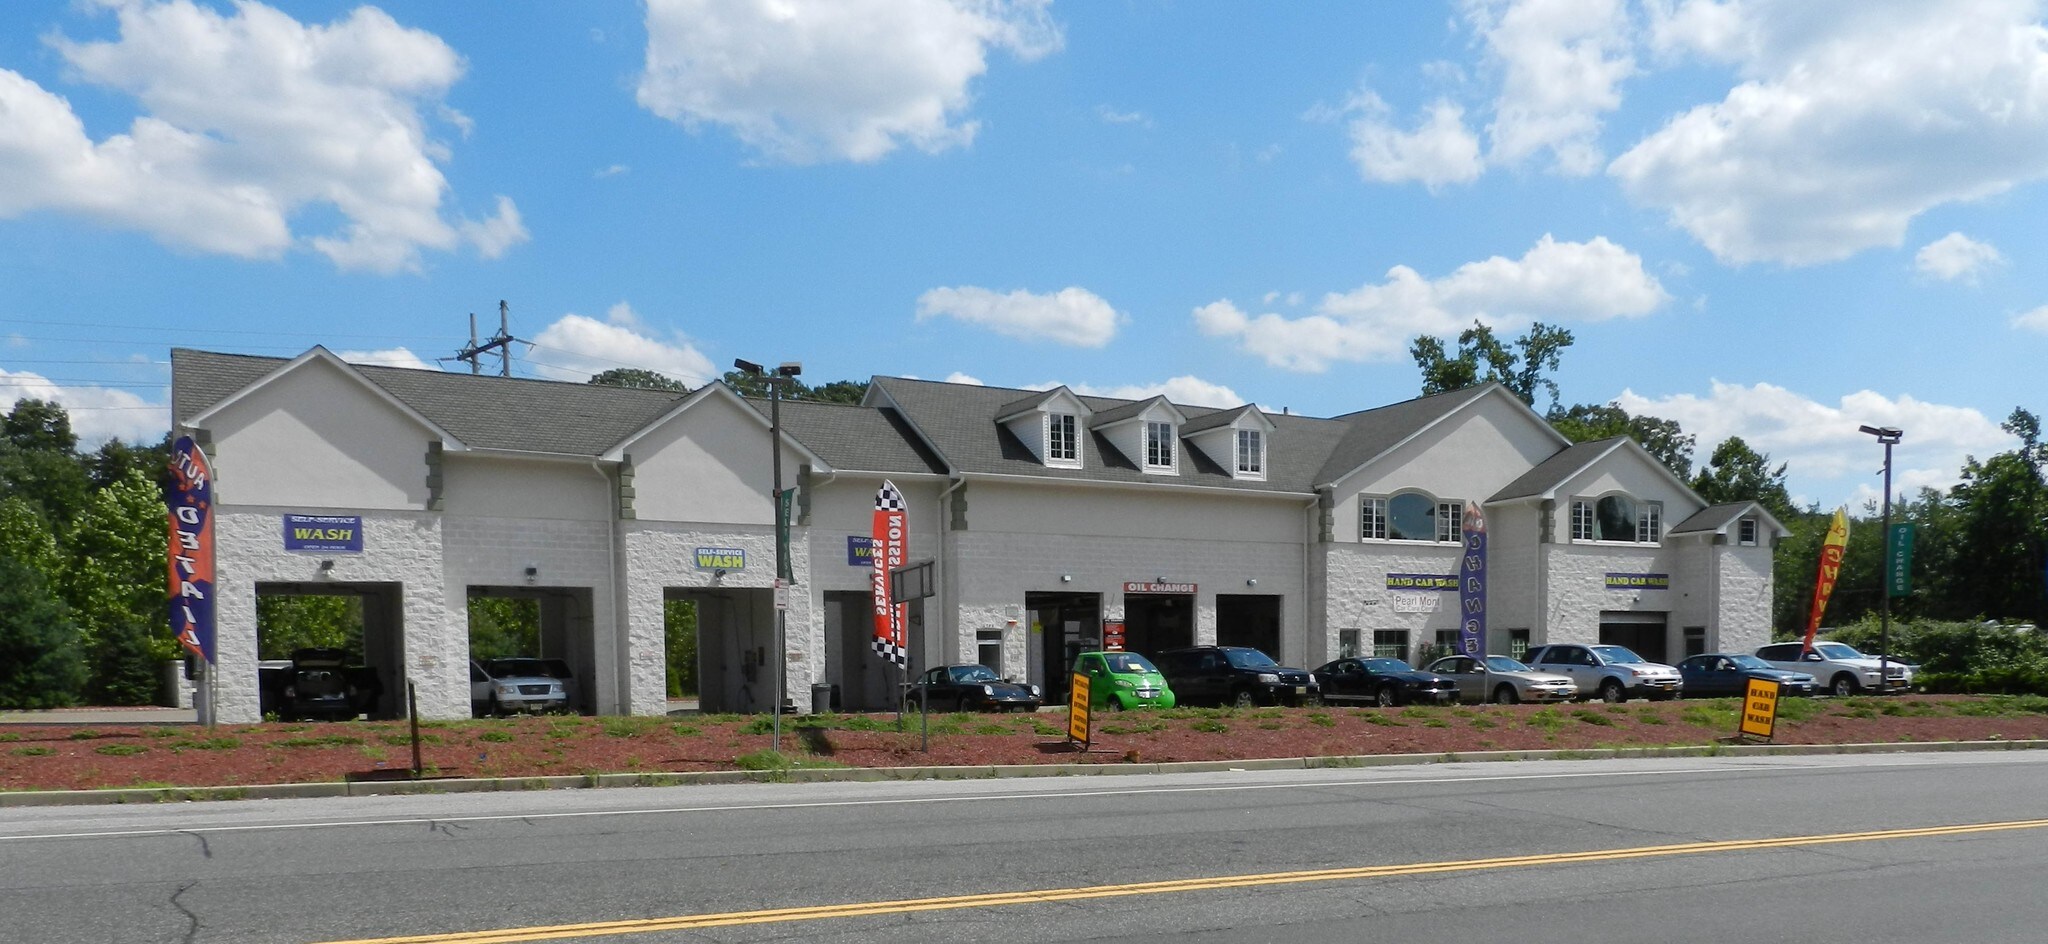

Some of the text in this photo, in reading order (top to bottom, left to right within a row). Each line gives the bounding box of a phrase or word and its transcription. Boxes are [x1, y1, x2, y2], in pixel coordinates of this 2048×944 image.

[291, 515, 356, 524] SELF-SERVICE
[294, 528, 353, 541] WASH
[1898, 527, 1907, 547] OIL
[855, 547, 874, 556] WA
[698, 555, 743, 568] WASH
[1895, 551, 1905, 590] CHANGE
[1387, 577, 1459, 587] HAND CAR WASH
[1606, 576, 1629, 585] HAND
[1630, 577, 1647, 585] CAR
[1127, 583, 1194, 592] OIL CHANGE
[1395, 596, 1417, 605] Pearl
[1751, 689, 1775, 699] HAND
[1753, 702, 1770, 711] CAR
[1748, 714, 1771, 724] WASH
